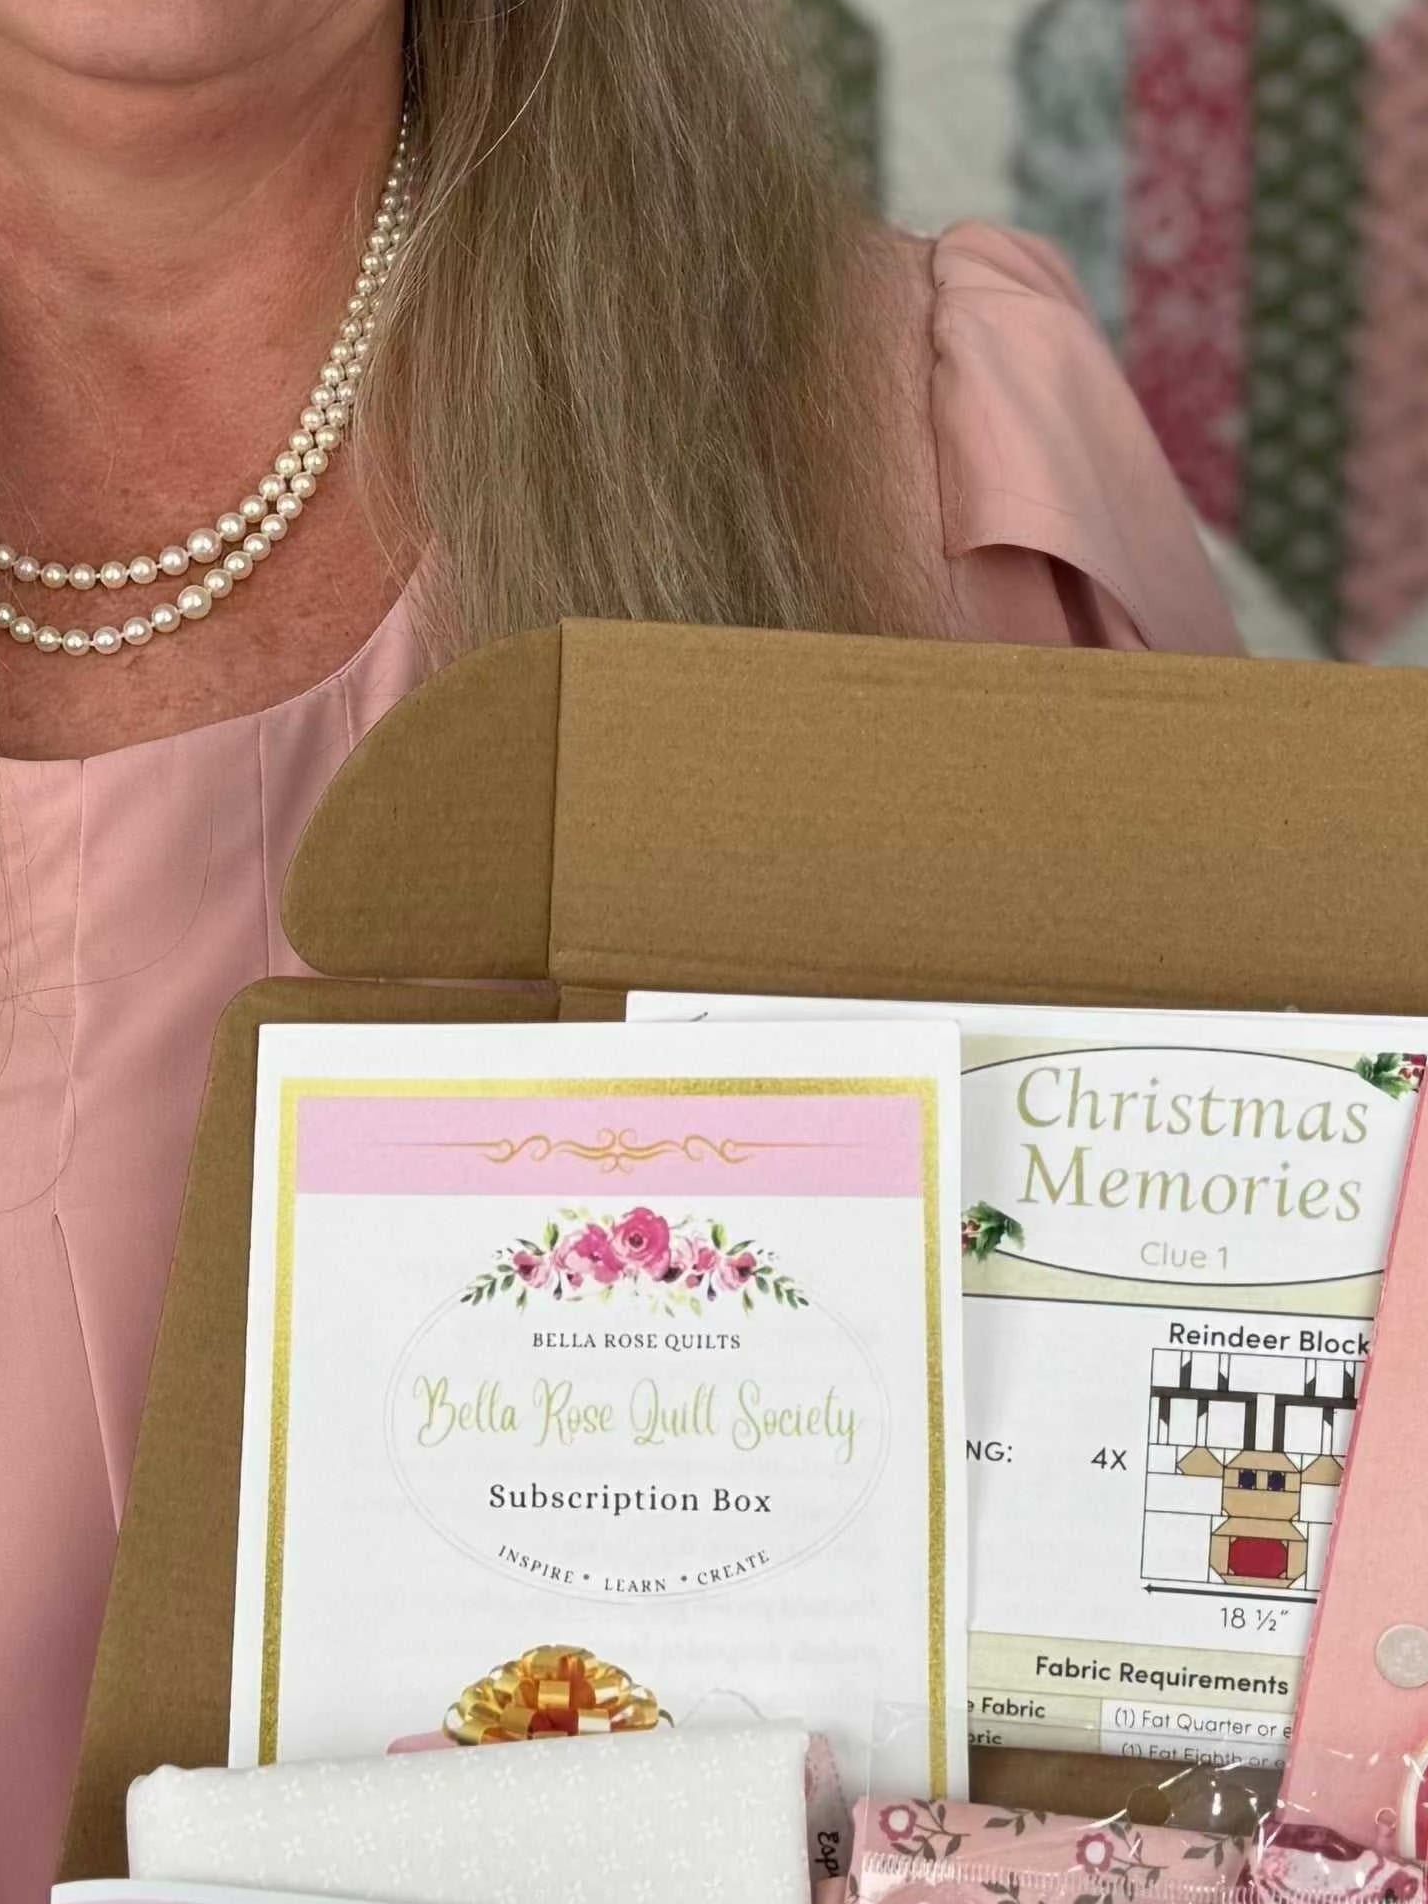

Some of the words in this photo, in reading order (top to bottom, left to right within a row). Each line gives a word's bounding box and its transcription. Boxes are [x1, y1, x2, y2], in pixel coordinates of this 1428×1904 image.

[1016, 1066, 1369, 1145] Christmas
[1017, 1143, 1363, 1222] Memories
[1140, 1241, 1206, 1269] Clue
[1217, 1246, 1229, 1269] 1
[533, 1333, 596, 1349] BELLA
[605, 1334, 657, 1350] ROSE
[665, 1334, 741, 1353] QUILTS
[1169, 1323, 1290, 1353] Reindeer
[1299, 1328, 1370, 1356] Block
[413, 1375, 521, 1447] Bella
[532, 1377, 616, 1447] Rose
[732, 1378, 862, 1465] Society
[1091, 1447, 1127, 1471] 4X
[489, 1484, 699, 1517] Subscription
[712, 1487, 773, 1514] Box
[498, 1545, 575, 1585] INSPIRE
[604, 1577, 667, 1594] LEARN
[697, 1549, 770, 1587] CREATE
[1221, 1607, 1245, 1629] 18
[1036, 1656, 1110, 1682] Fabric
[1119, 1663, 1289, 1695] Requirements
[981, 1697, 1045, 1719] Fabric
[1114, 1707, 1136, 1728] (1)
[1142, 1710, 1170, 1729] Fat
[1177, 1713, 1252, 1736] Quarter
[1258, 1724, 1277, 1737] or
